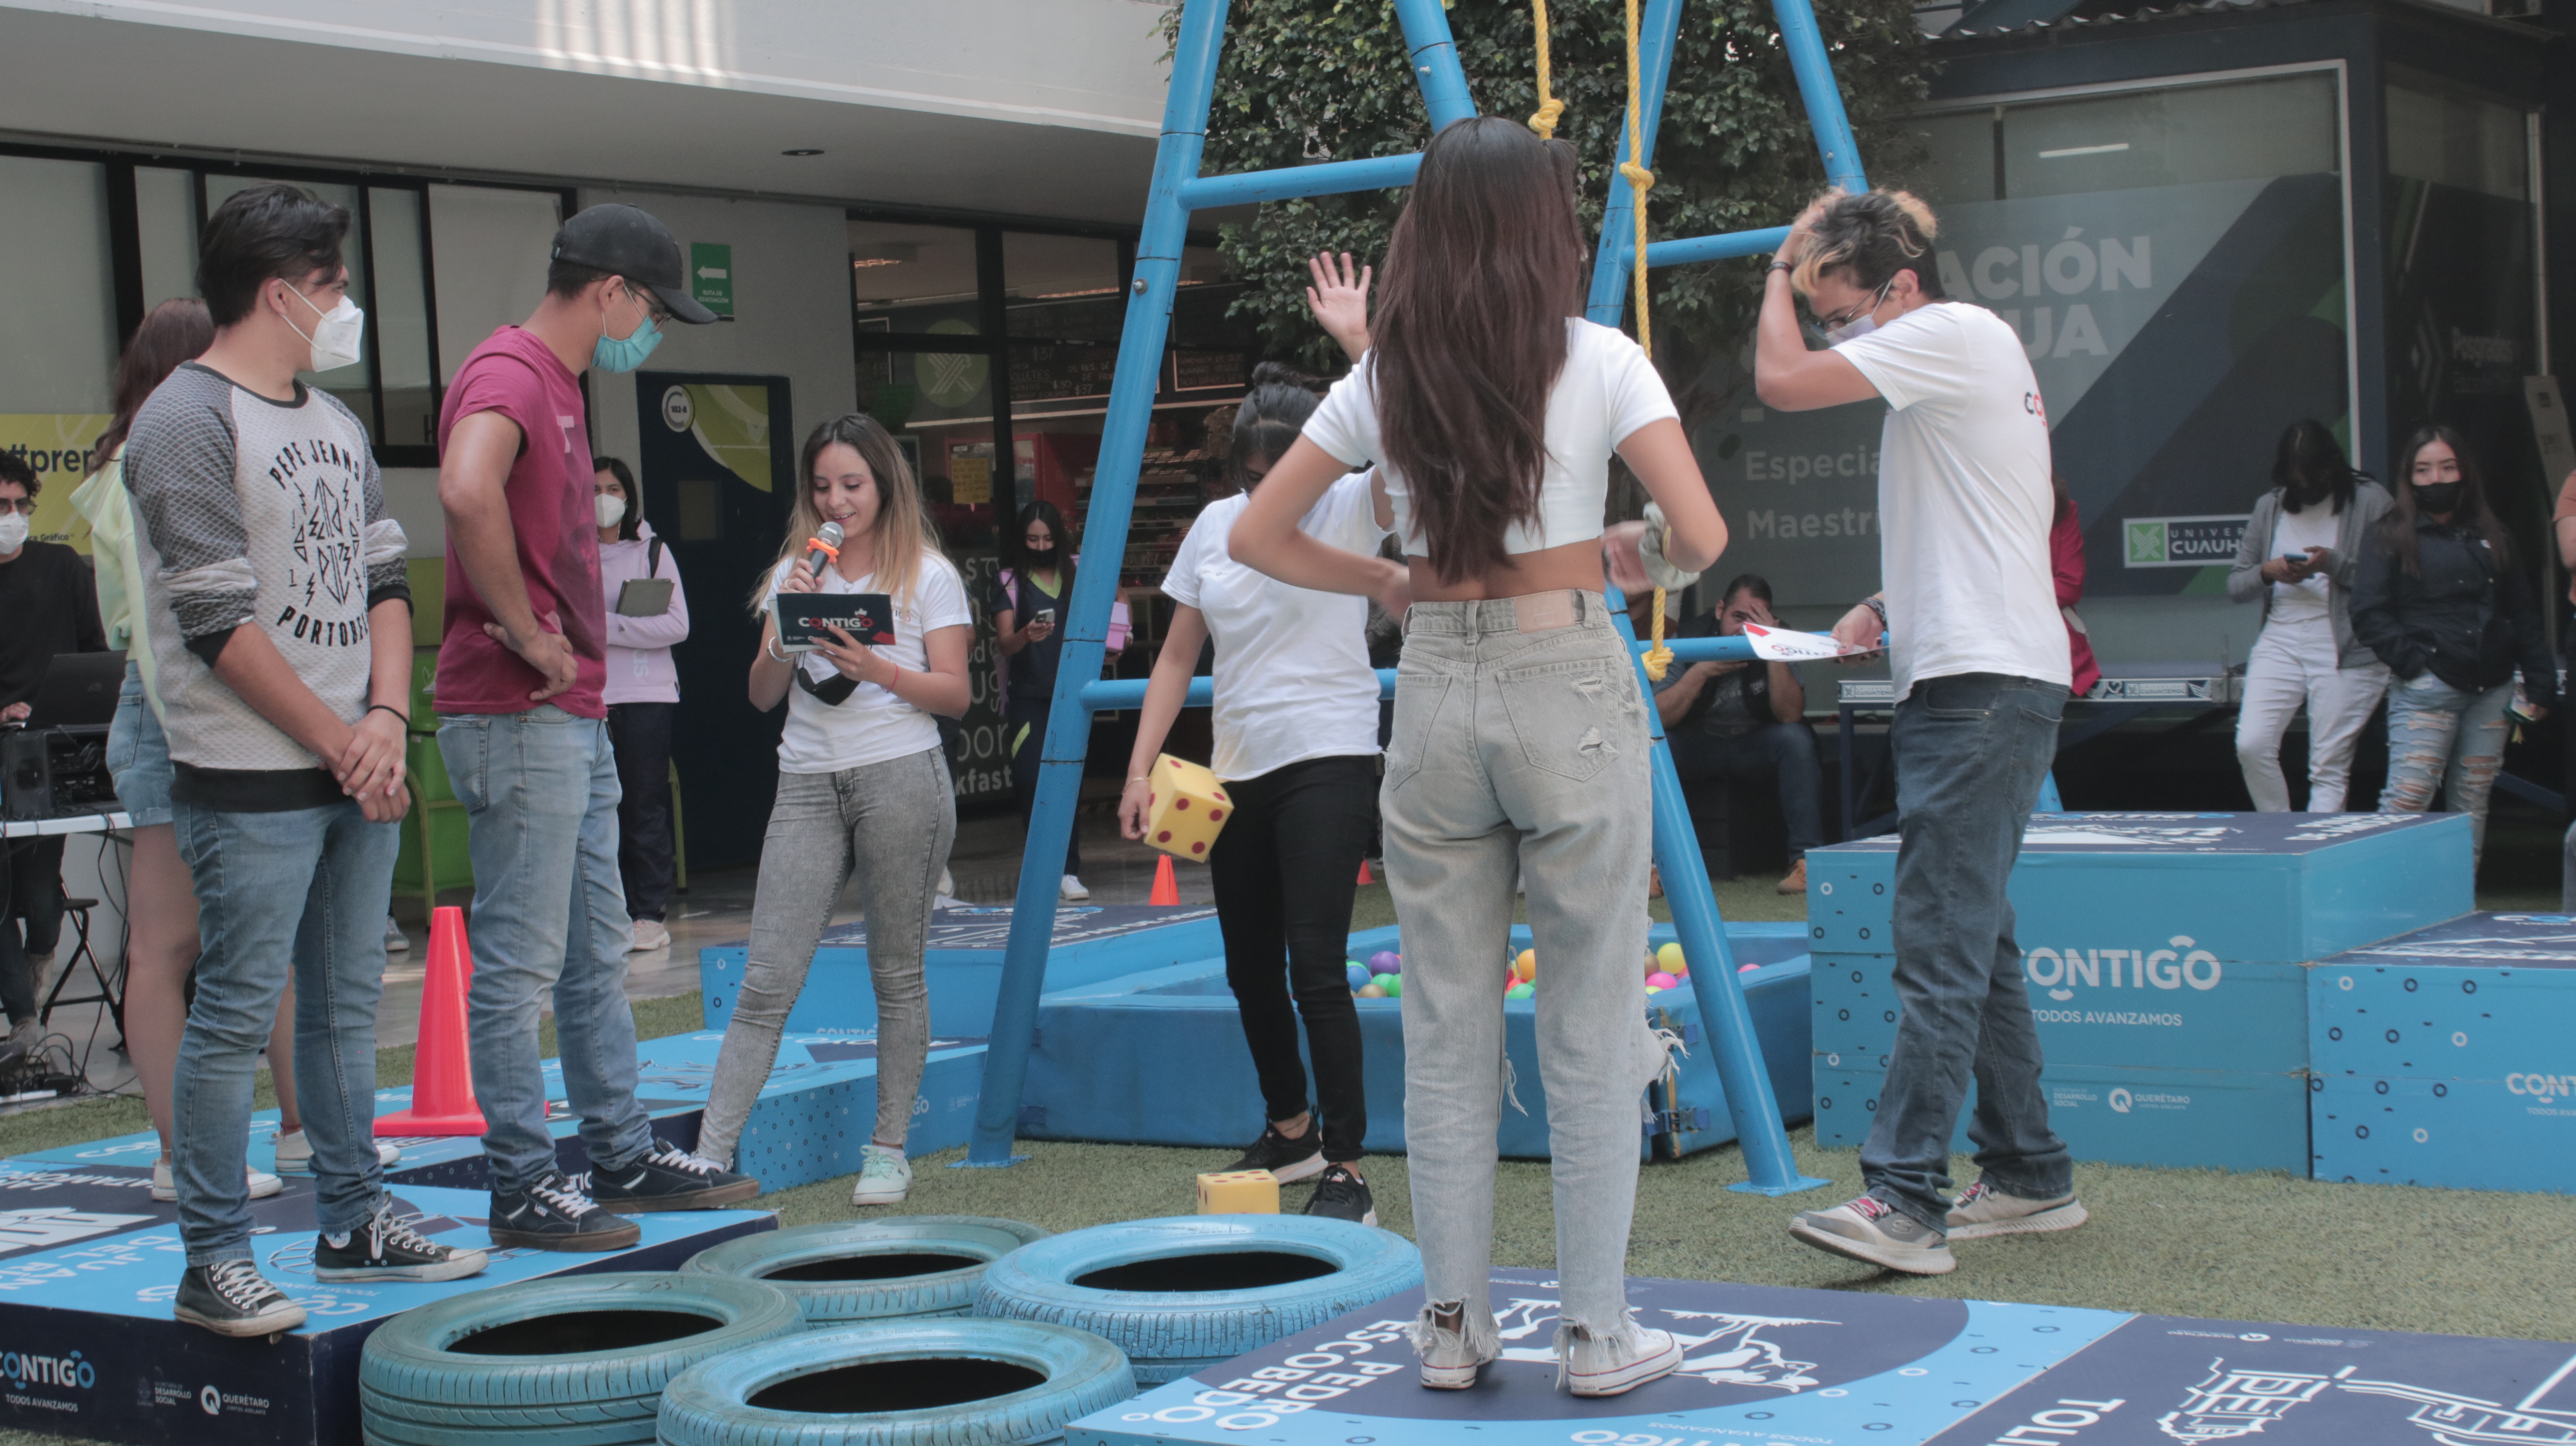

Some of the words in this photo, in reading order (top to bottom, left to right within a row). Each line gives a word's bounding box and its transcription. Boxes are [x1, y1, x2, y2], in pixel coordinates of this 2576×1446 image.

[270, 442, 306, 490] PEPE
[309, 440, 359, 482] JEANS
[799, 615, 874, 630] CONTIGO
[2018, 939, 2221, 997] ONTIGO
[2086, 1011, 2182, 1027] AVANZAMOS
[2054, 1093, 2098, 1101] DESARROLLO
[2135, 1093, 2190, 1104] QUERÉTARO
[0, 1350, 95, 1390] ONTIGO
[155, 1387, 191, 1400] DESARROLLO
[155, 1395, 176, 1406] SOCIAL
[222, 1393, 269, 1409] QUERÉTARO
[1215, 1360, 1405, 1431] PEDRO
[6, 1393, 31, 1406] TODOS
[32, 1396, 78, 1413] AVANZAMOS
[1647, 1422, 1767, 1438] AVANZAMOS
[1769, 1433, 1834, 1444] TODOS
